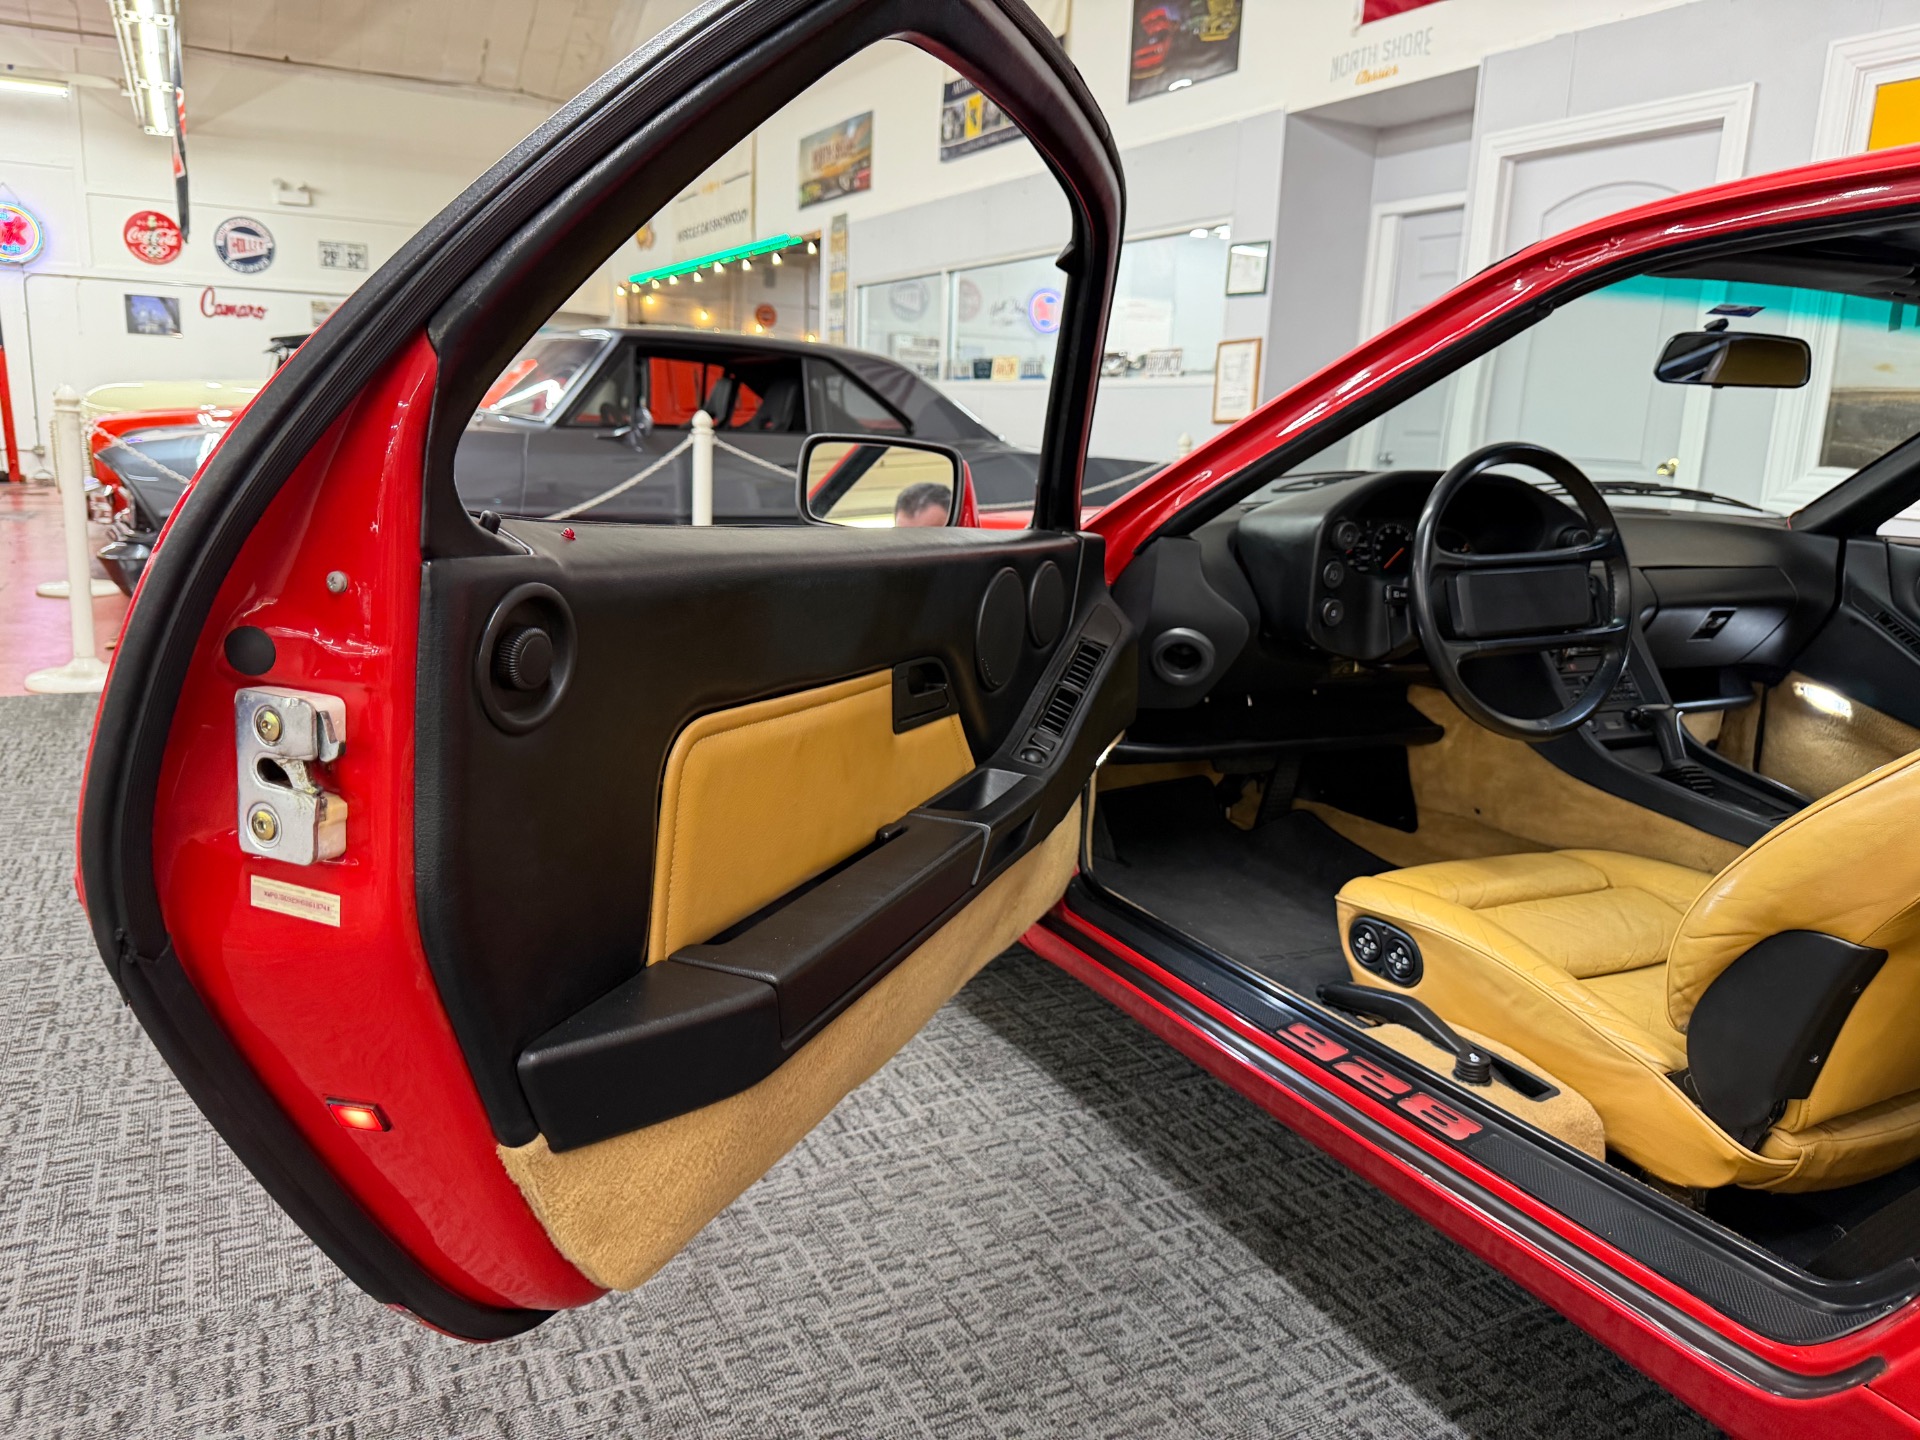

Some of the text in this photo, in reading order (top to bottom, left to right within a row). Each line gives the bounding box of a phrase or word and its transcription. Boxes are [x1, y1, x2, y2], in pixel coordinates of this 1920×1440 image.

[1330, 26, 1433, 82] NORTH SHORE
[200, 286, 268, 320] Camaro
[1276, 1022, 1484, 1141] 928
